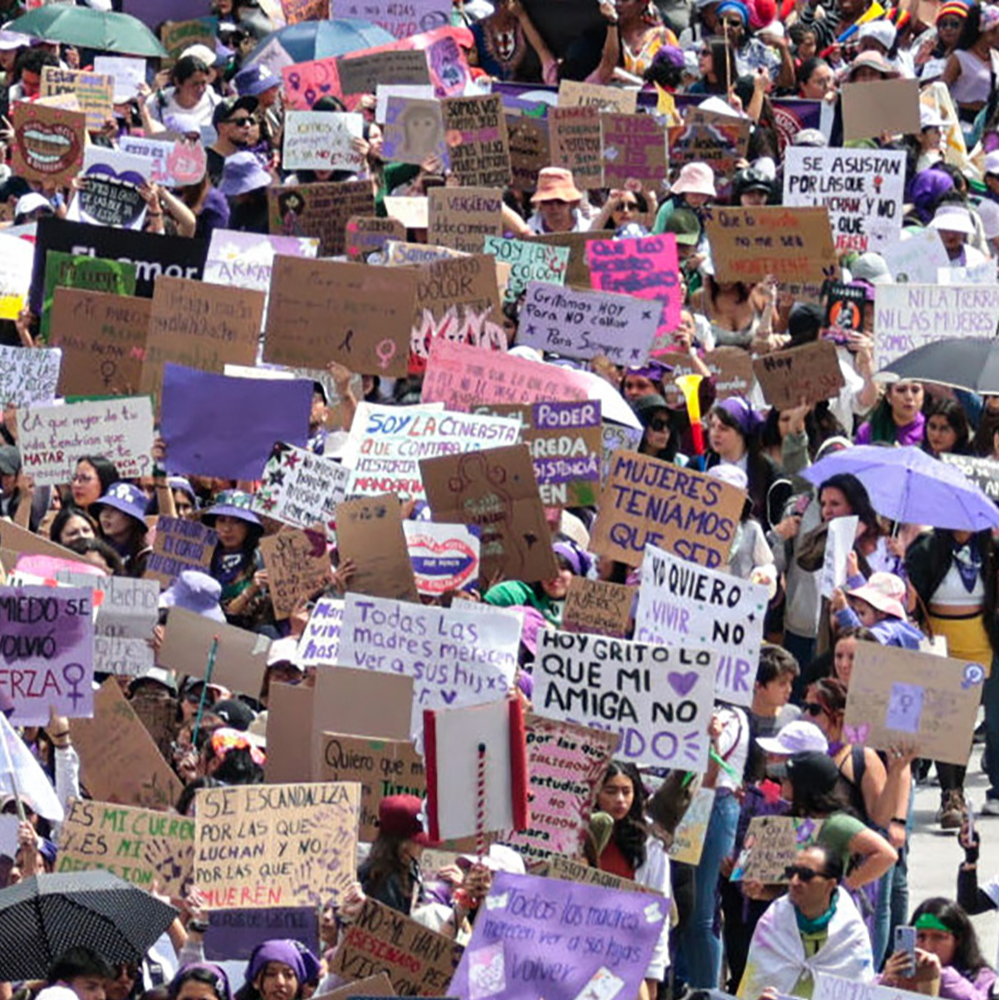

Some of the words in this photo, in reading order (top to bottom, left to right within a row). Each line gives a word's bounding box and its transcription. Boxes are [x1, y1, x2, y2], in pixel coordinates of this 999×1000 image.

[803, 157, 823, 171] SE
[831, 156, 900, 174] ASUSTAN
[789, 176, 815, 193] POR
[820, 175, 843, 191] LAS
[844, 178, 865, 192] QUE
[877, 200, 895, 219] NO
[838, 217, 865, 234] QUE
[366, 413, 411, 436] SOY
[409, 415, 436, 436] LA
[537, 406, 595, 426] PODER
[614, 456, 722, 507] MUJERES
[612, 484, 734, 542] TENÍAMOS
[669, 563, 742, 609] QUIERO
[65, 598, 90, 617] SE
[354, 601, 427, 637] Todas
[438, 612, 478, 641] Las
[651, 601, 690, 633] VIVIR
[712, 619, 745, 645] NO
[354, 625, 433, 657] madres
[542, 633, 588, 652] HOY
[591, 638, 671, 665] GRITO
[678, 646, 711, 665] LO
[354, 650, 383, 668] ver
[412, 665, 450, 683] sus
[542, 652, 602, 683] QUE
[616, 669, 651, 691] MI
[544, 681, 639, 724] AMIGA
[651, 700, 698, 723] NO
[530, 776, 589, 796] estudiar
[205, 788, 238, 818] SE
[68, 803, 93, 826] ES
[103, 811, 127, 832] MI
[200, 823, 231, 841] POR
[238, 821, 268, 839] LAS
[276, 820, 310, 836] QUE
[200, 845, 265, 862] LUCHAN
[278, 841, 287, 857] Y
[297, 838, 321, 855] NO
[227, 866, 252, 880] LAS
[259, 863, 291, 878] QUE
[200, 886, 282, 907] MUEREN
